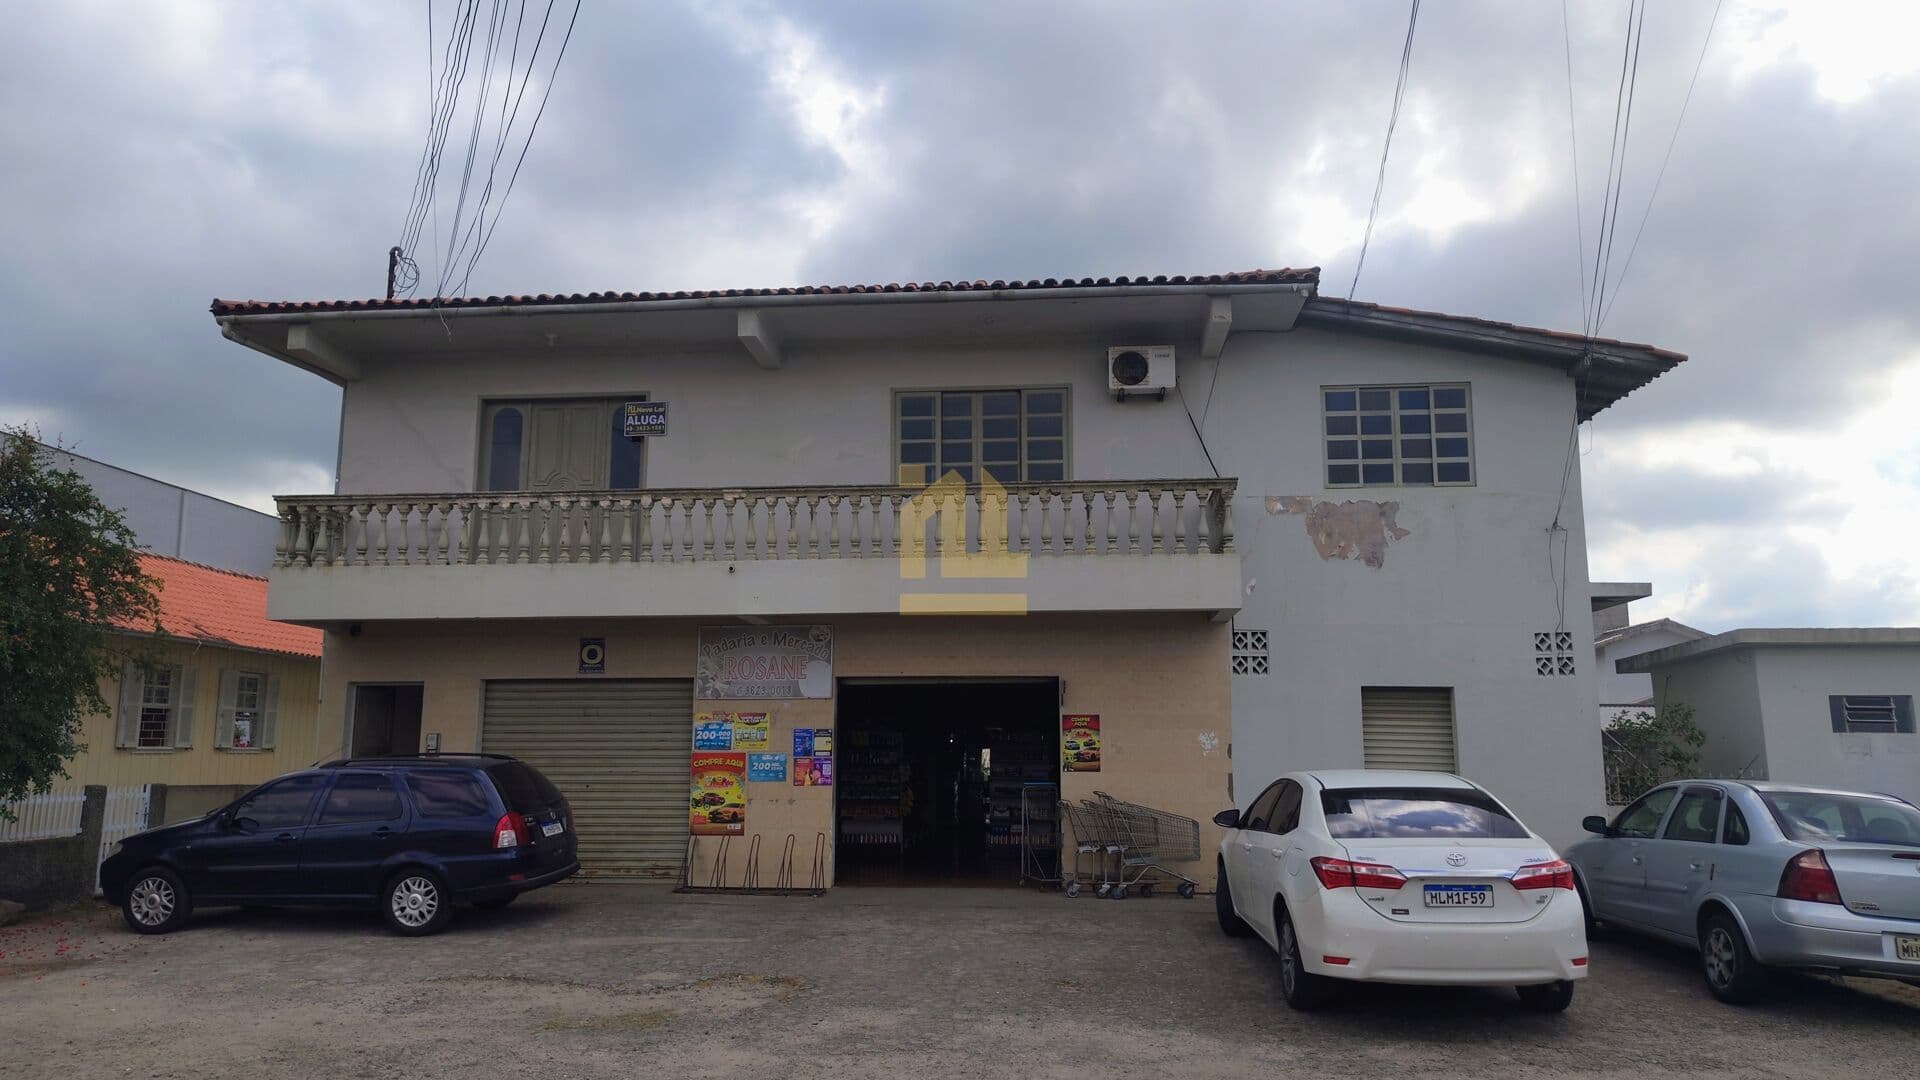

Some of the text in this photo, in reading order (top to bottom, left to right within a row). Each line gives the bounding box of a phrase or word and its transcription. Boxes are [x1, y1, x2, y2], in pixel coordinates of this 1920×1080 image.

[627, 415, 665, 425] ALUGA
[703, 631, 829, 659] Padaria e Mercado
[724, 656, 808, 680] ROSANE
[693, 758, 744, 768] COMPRE AQUI
[752, 762, 771, 771] 200
